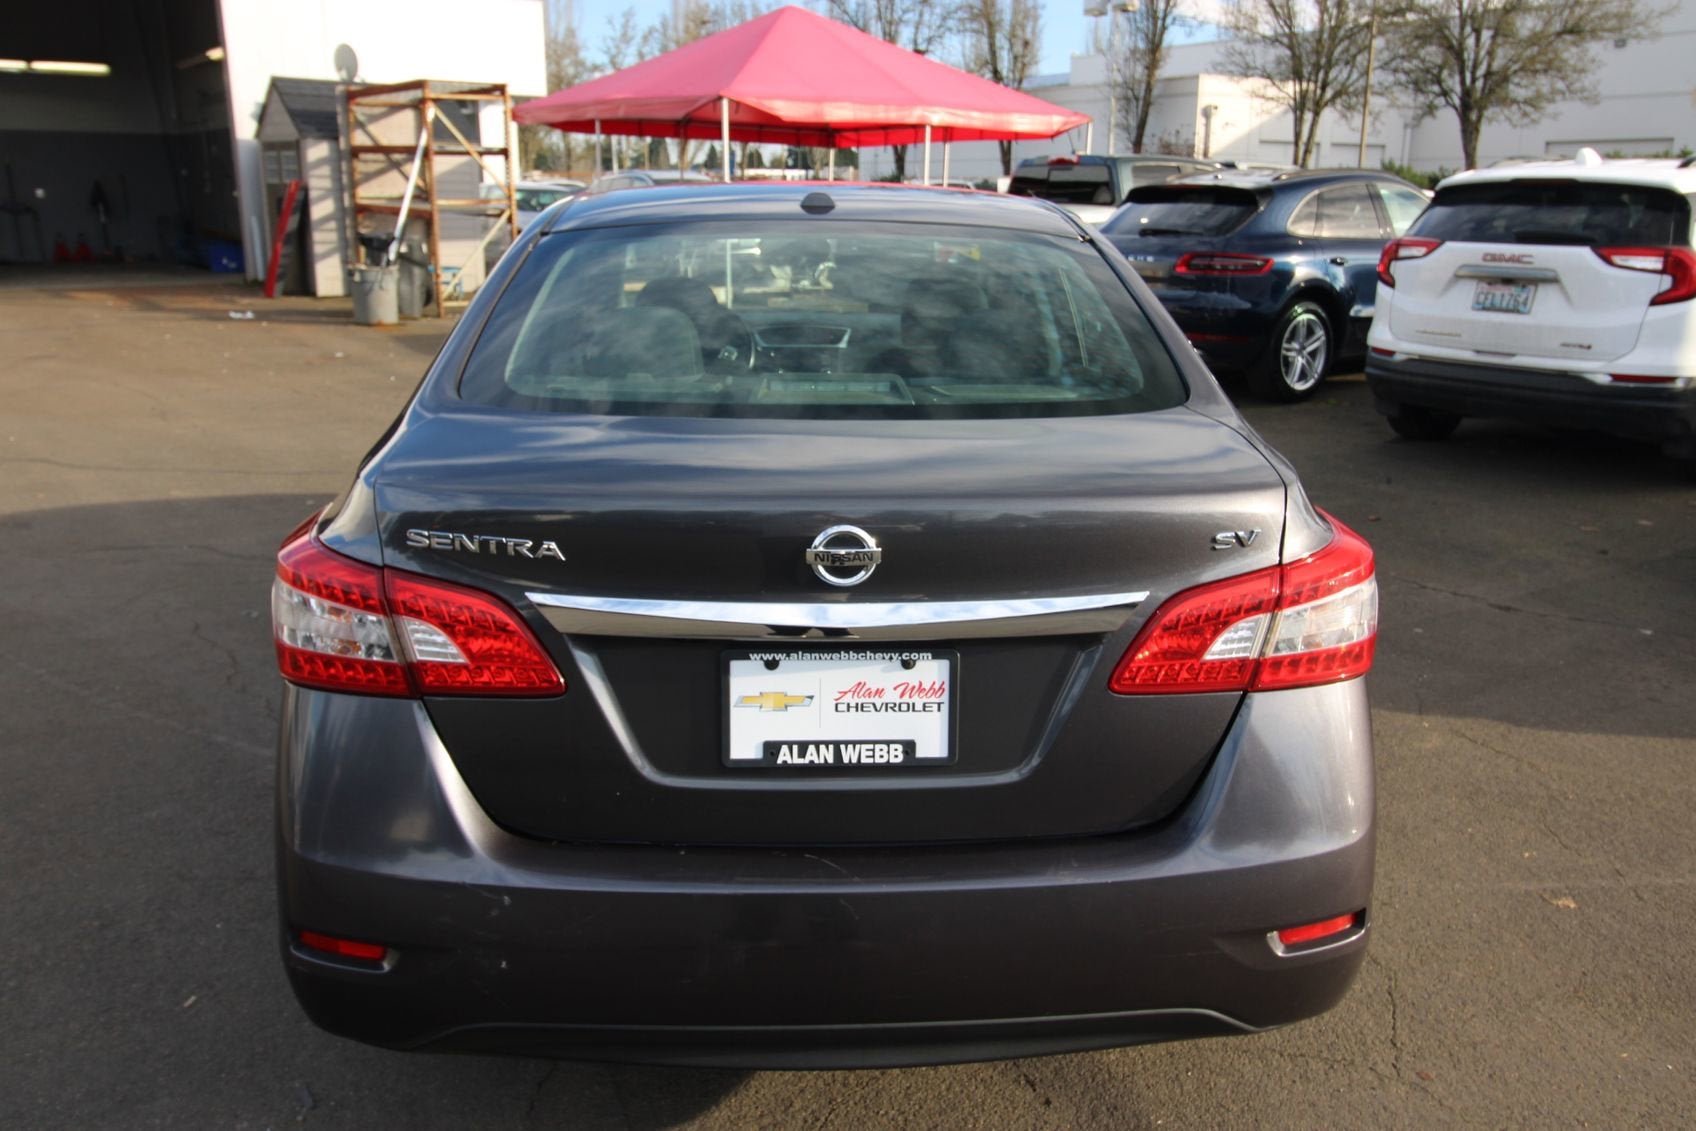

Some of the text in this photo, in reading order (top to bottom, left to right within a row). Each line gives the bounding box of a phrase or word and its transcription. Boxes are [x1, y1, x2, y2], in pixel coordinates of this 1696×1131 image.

[1482, 252, 1534, 264] GMC
[406, 528, 566, 561] SENTRA
[1212, 529, 1261, 549] SV
[814, 552, 873, 563] NISSAN
[749, 651, 932, 661] www.alanwebbchevy.com
[834, 680, 946, 701] Alan Webb
[834, 702, 945, 713] CHEVROLET
[776, 744, 904, 765] ALAN WEBB
